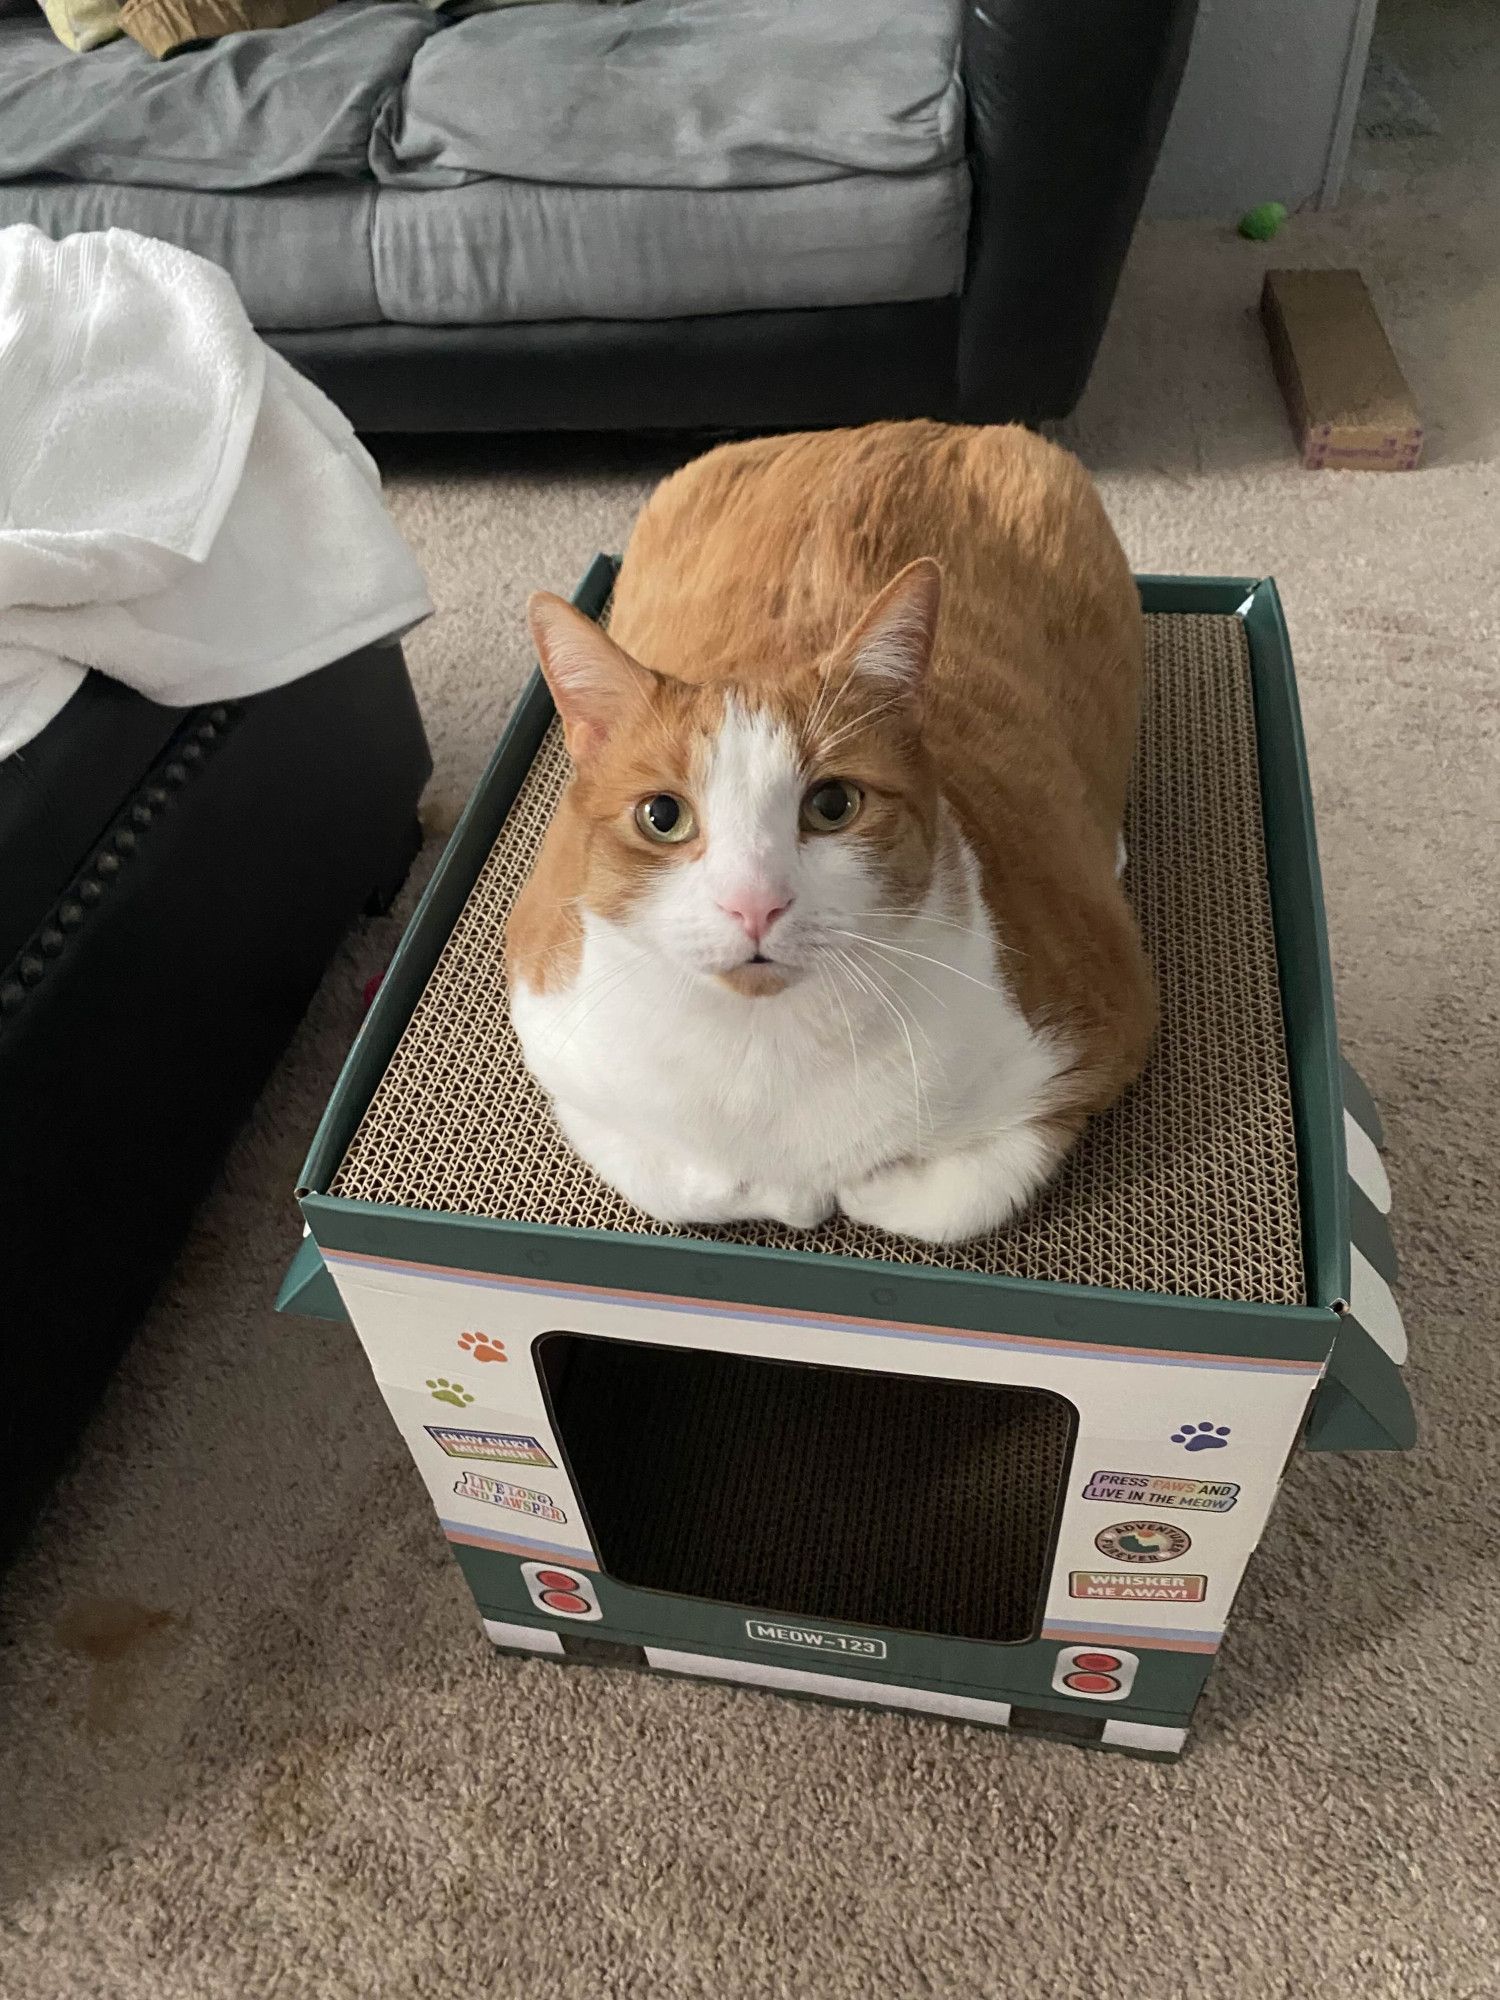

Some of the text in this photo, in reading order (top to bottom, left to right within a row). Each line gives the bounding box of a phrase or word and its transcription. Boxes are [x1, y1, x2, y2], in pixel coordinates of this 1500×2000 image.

[441, 1433, 530, 1449] ENJOY EVERY
[470, 1475, 548, 1504] LIVE LONG
[1099, 1474, 1232, 1497] PRESS PAWS AND
[460, 1486, 562, 1521] AND PAWSPER
[1091, 1488, 1228, 1509] LIVE IN THE MEOW
[1089, 1575, 1185, 1587] WHISKER
[1086, 1587, 1188, 1599] ME AWAY!
[756, 1625, 876, 1653] MEOW-123
